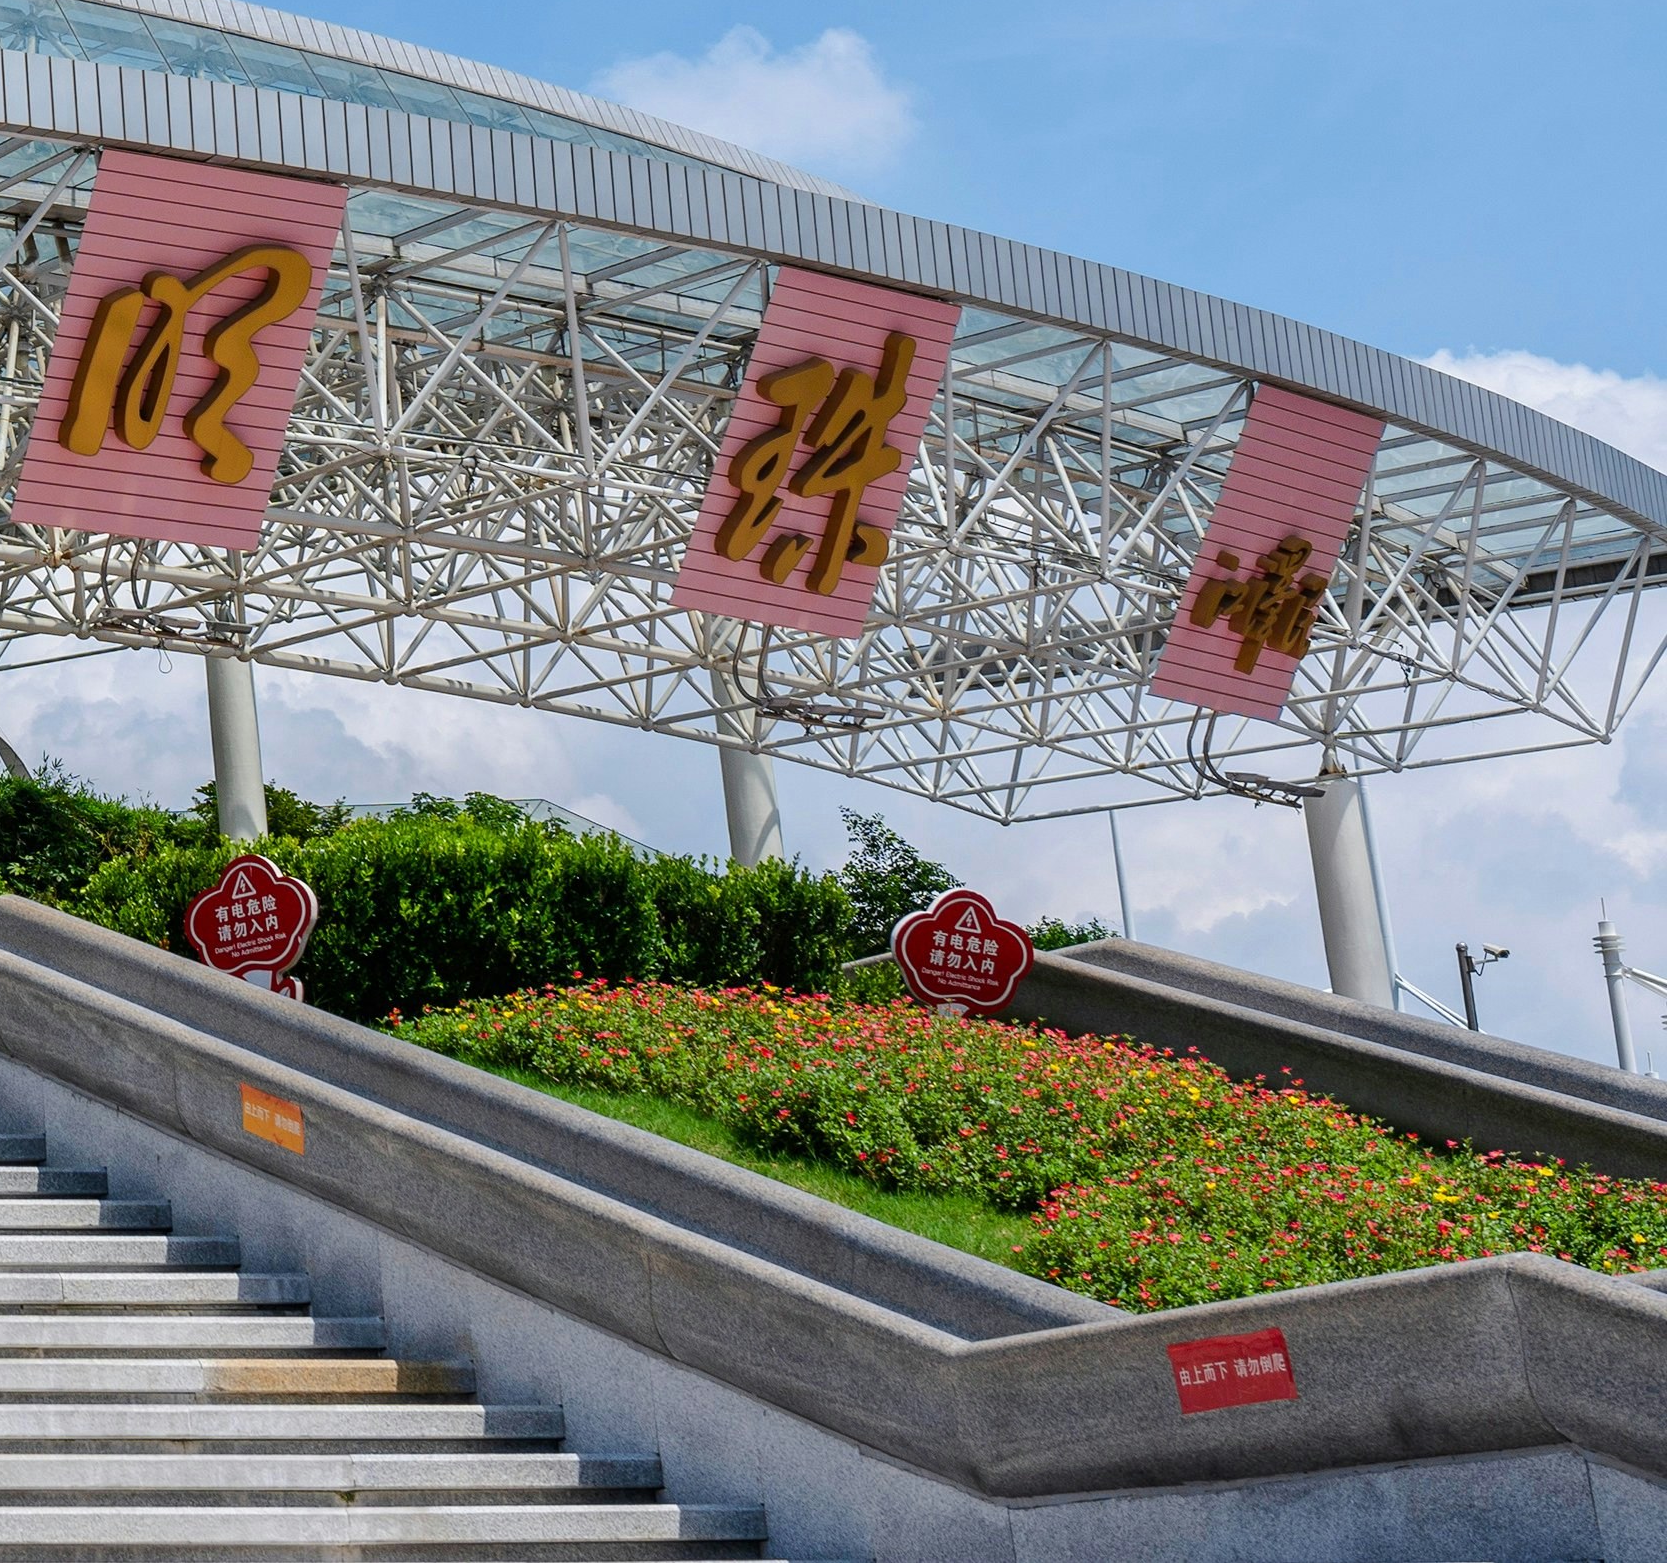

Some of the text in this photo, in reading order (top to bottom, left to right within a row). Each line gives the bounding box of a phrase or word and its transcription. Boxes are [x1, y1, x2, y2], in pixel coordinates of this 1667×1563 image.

[58, 244, 312, 484] 明
[714, 331, 917, 597] 珠
[215, 894, 278, 923] 有电危险
[217, 914, 279, 942] 请勿入内
[932, 930, 999, 956] 有电危险
[929, 948, 995, 975] 请勿入内
[1179, 1353, 1287, 1386] 由上而下 请勿倒爬
